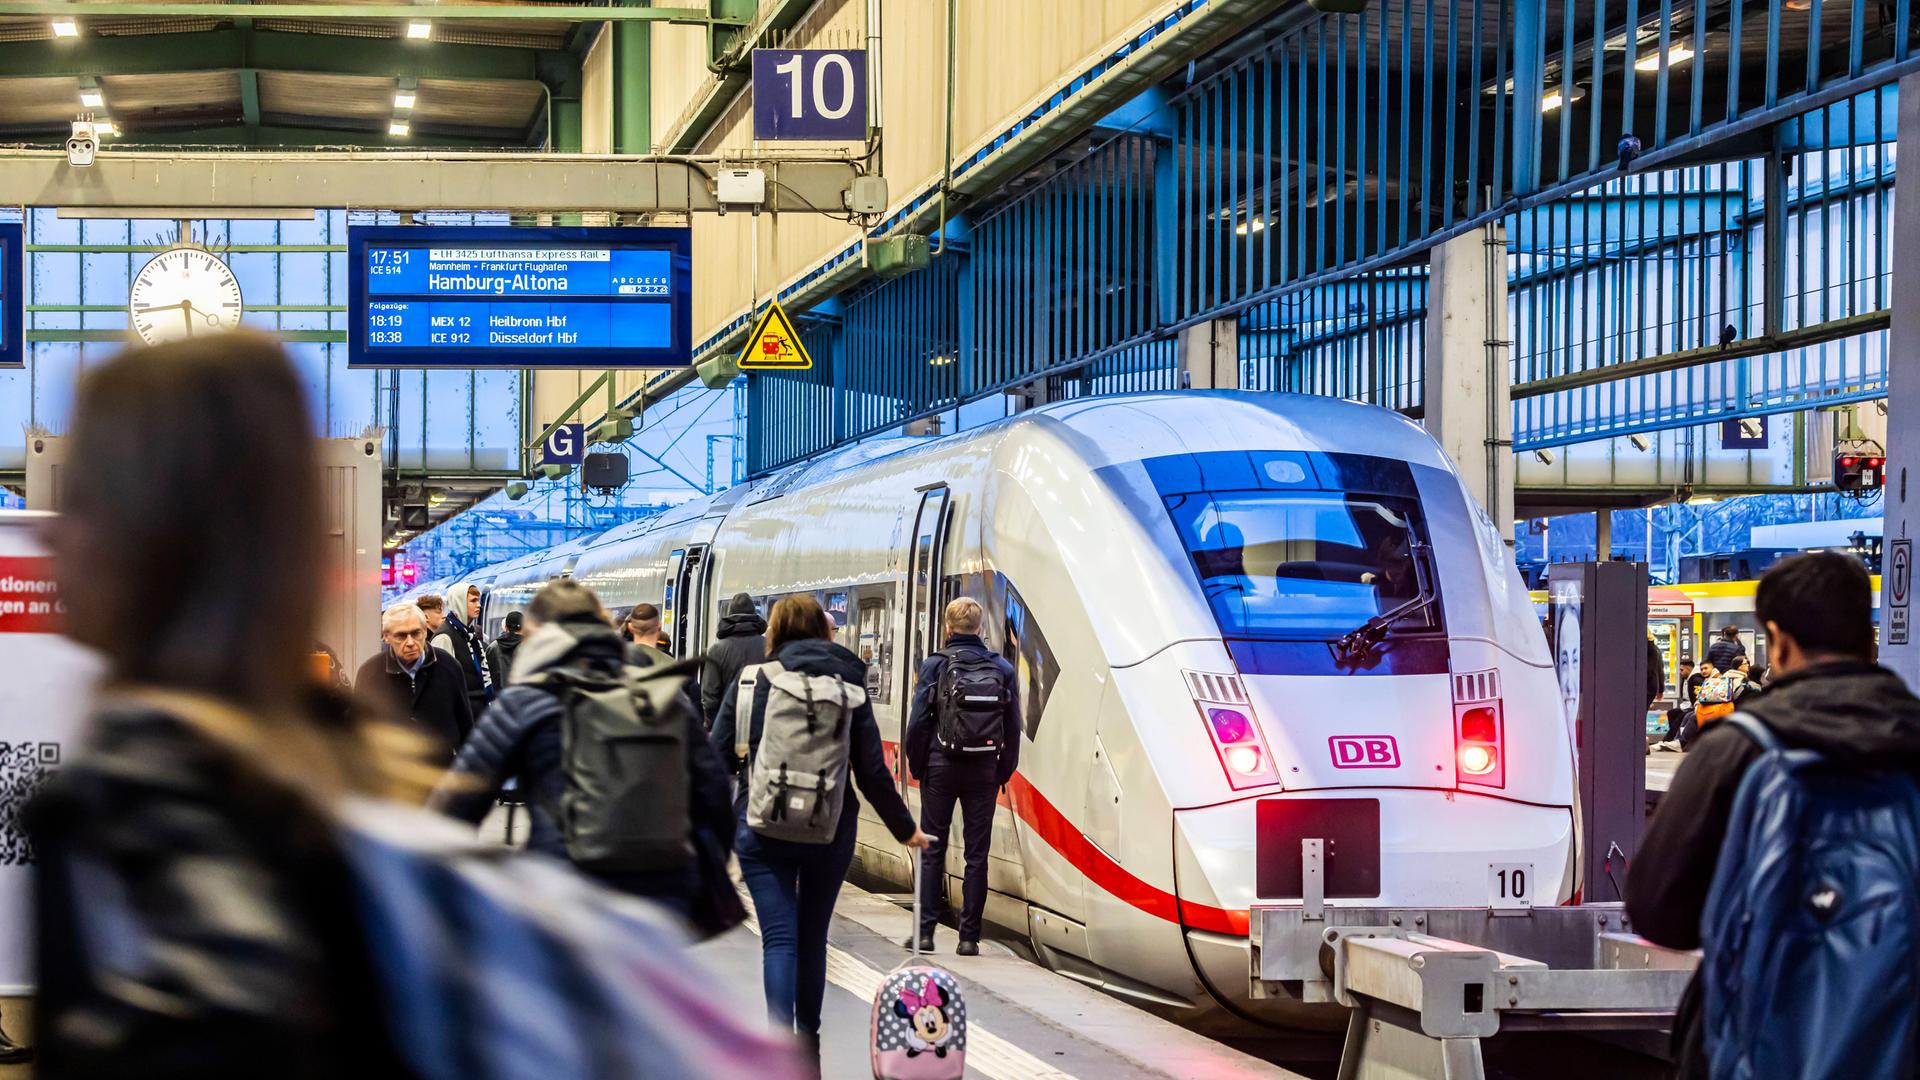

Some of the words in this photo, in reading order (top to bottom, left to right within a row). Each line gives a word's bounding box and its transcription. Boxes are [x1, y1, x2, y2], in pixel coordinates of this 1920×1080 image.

[776, 53, 855, 120] 10
[371, 251, 410, 264] 17:51
[440, 250, 452, 258] LH
[455, 250, 478, 258] 3425
[480, 250, 533, 258] Lufthansa
[535, 250, 578, 260] Express
[580, 250, 599, 258] Rail
[370, 266, 383, 274] ICE
[385, 266, 401, 274] 514
[429, 262, 471, 271] Mannheim
[481, 262, 523, 271] Frankfurt
[524, 262, 568, 273] Flughafen
[429, 273, 568, 294] Hamburg-Altona
[369, 302, 409, 310] Folgezüge:
[370, 315, 402, 327] 18:19
[431, 316, 454, 327] MEX
[458, 316, 471, 327] 12
[489, 315, 543, 327] Heilbronn
[546, 315, 567, 327] Hbf
[370, 331, 402, 343] 18:38
[431, 333, 447, 343] ICE
[450, 333, 470, 343] 912
[489, 331, 553, 343] Düsseldorf
[557, 332, 578, 343] Hbf
[548, 425, 573, 456] G
[28, 601, 51, 613] an
[1337, 740, 1392, 763] DB
[1497, 869, 1525, 898] 10
